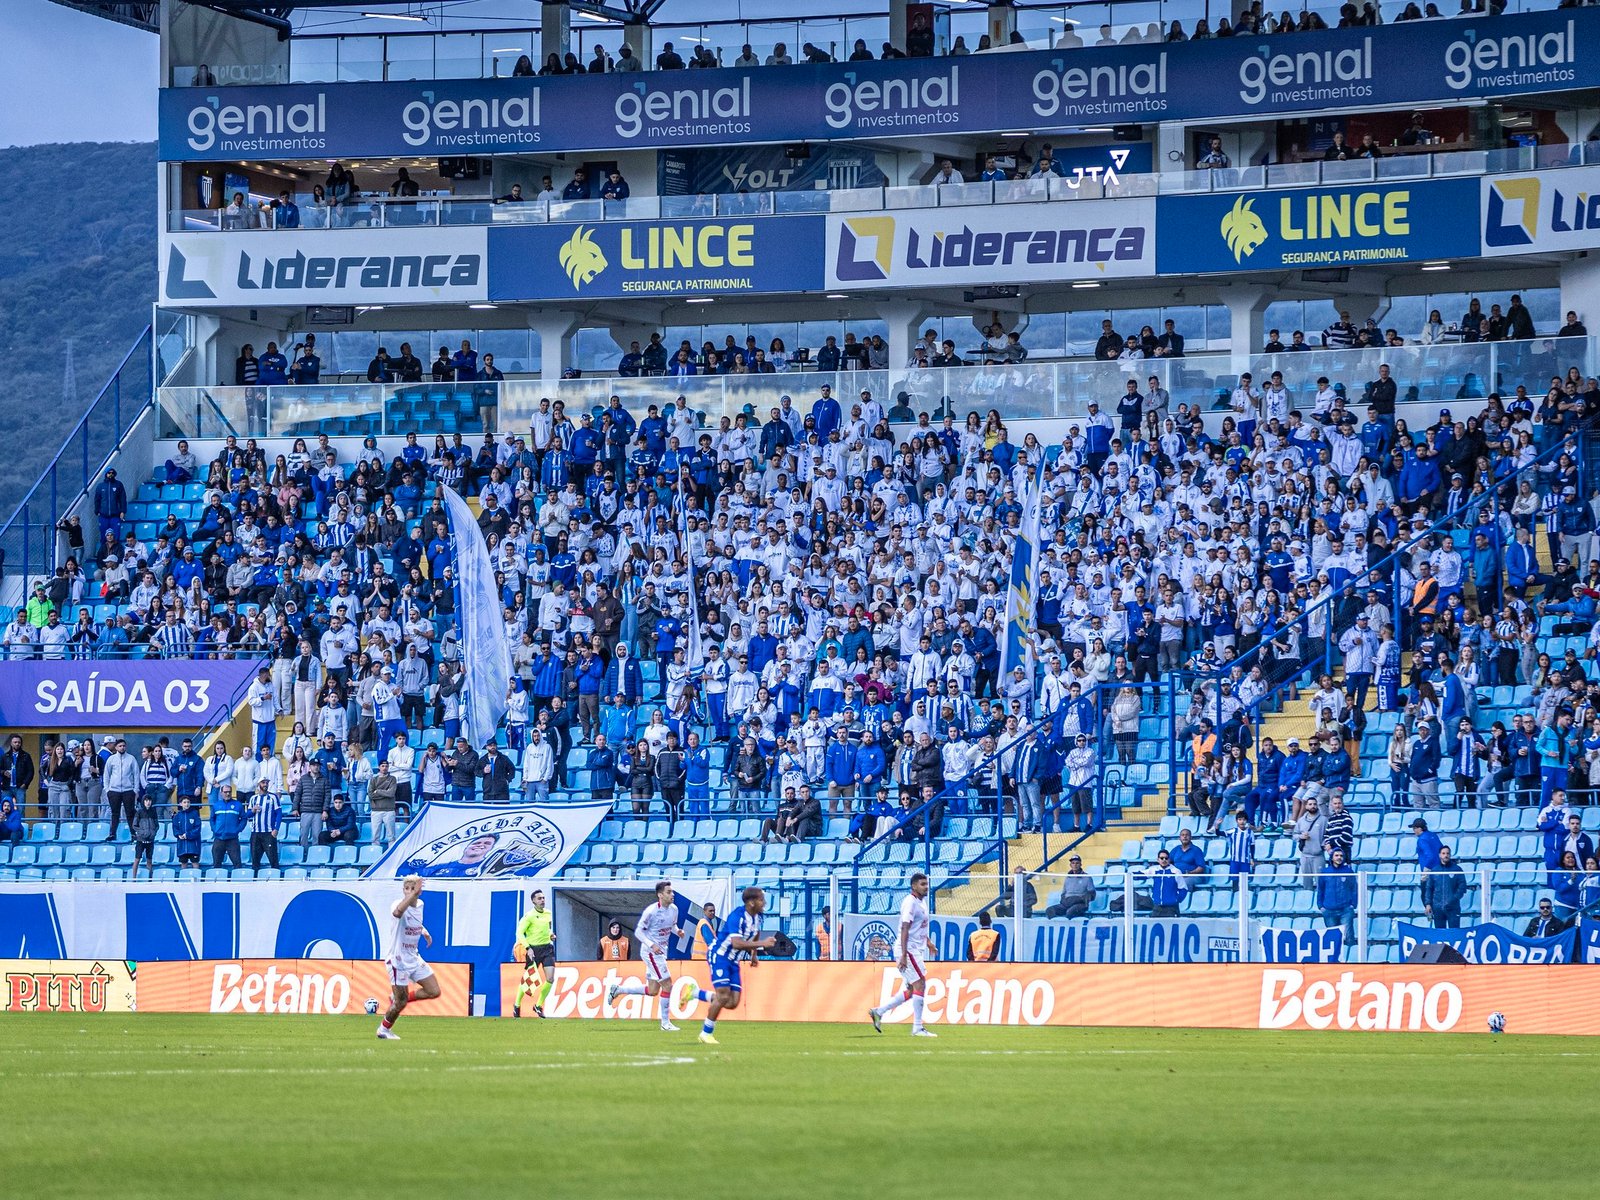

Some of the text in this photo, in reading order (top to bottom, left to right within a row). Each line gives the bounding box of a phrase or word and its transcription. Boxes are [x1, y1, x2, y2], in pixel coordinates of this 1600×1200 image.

[1240, 36, 1372, 104] genial
[1444, 19, 1575, 90] genial
[1477, 68, 1575, 88] investimentos
[615, 76, 750, 138] genial
[825, 65, 958, 128] genial
[1032, 51, 1167, 117] genial
[1065, 98, 1167, 116] investimentos
[1272, 84, 1372, 103] investimentos
[187, 93, 326, 151] genial
[402, 86, 540, 146] genial
[436, 129, 541, 146] investimentos
[648, 120, 751, 138] investimentos
[858, 110, 959, 128] investimentos
[220, 136, 326, 151] investimentos
[722, 163, 794, 191] VOLT
[1066, 165, 1120, 189] JTA
[1280, 190, 1410, 241] LINCE
[621, 224, 755, 270] LINCE
[906, 224, 1146, 272] Liderança
[1281, 247, 1409, 265] SEGURANÇA PATRIMONIAL
[237, 248, 481, 296] Liderança
[622, 277, 753, 292] SEGURANÇA PATRIMONIAL
[34, 671, 210, 713] SAÍDA 03
[6, 961, 110, 1012] PITÚ
[209, 964, 351, 1014] Betano
[1258, 968, 1463, 1032] Betano
